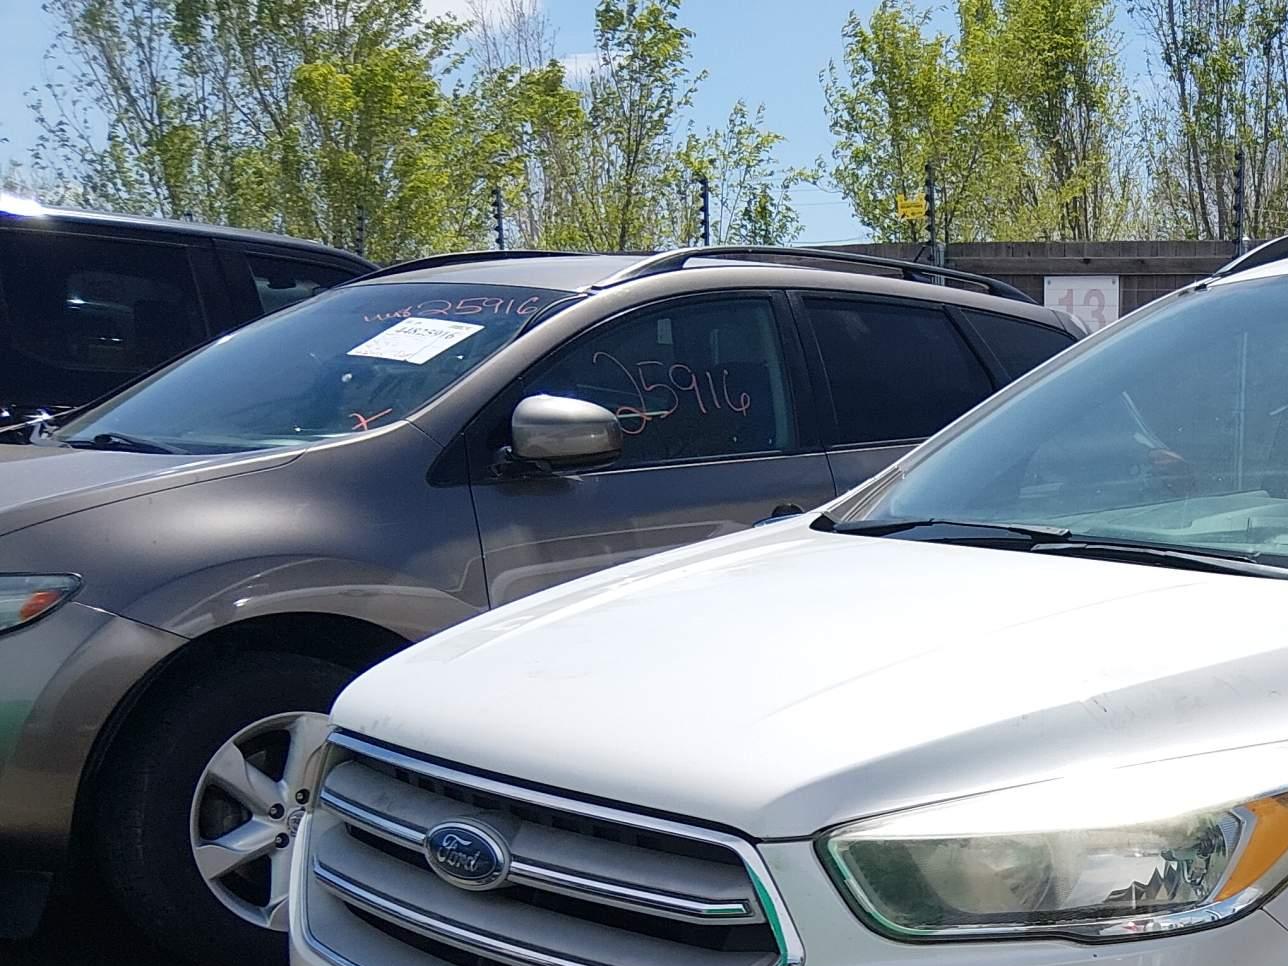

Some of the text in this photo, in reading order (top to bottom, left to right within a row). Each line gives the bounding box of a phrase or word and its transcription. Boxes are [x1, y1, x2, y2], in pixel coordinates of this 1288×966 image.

[1057, 288, 1107, 333] 13
[592, 351, 751, 435] 25916
[437, 833, 481, 872] Ford
